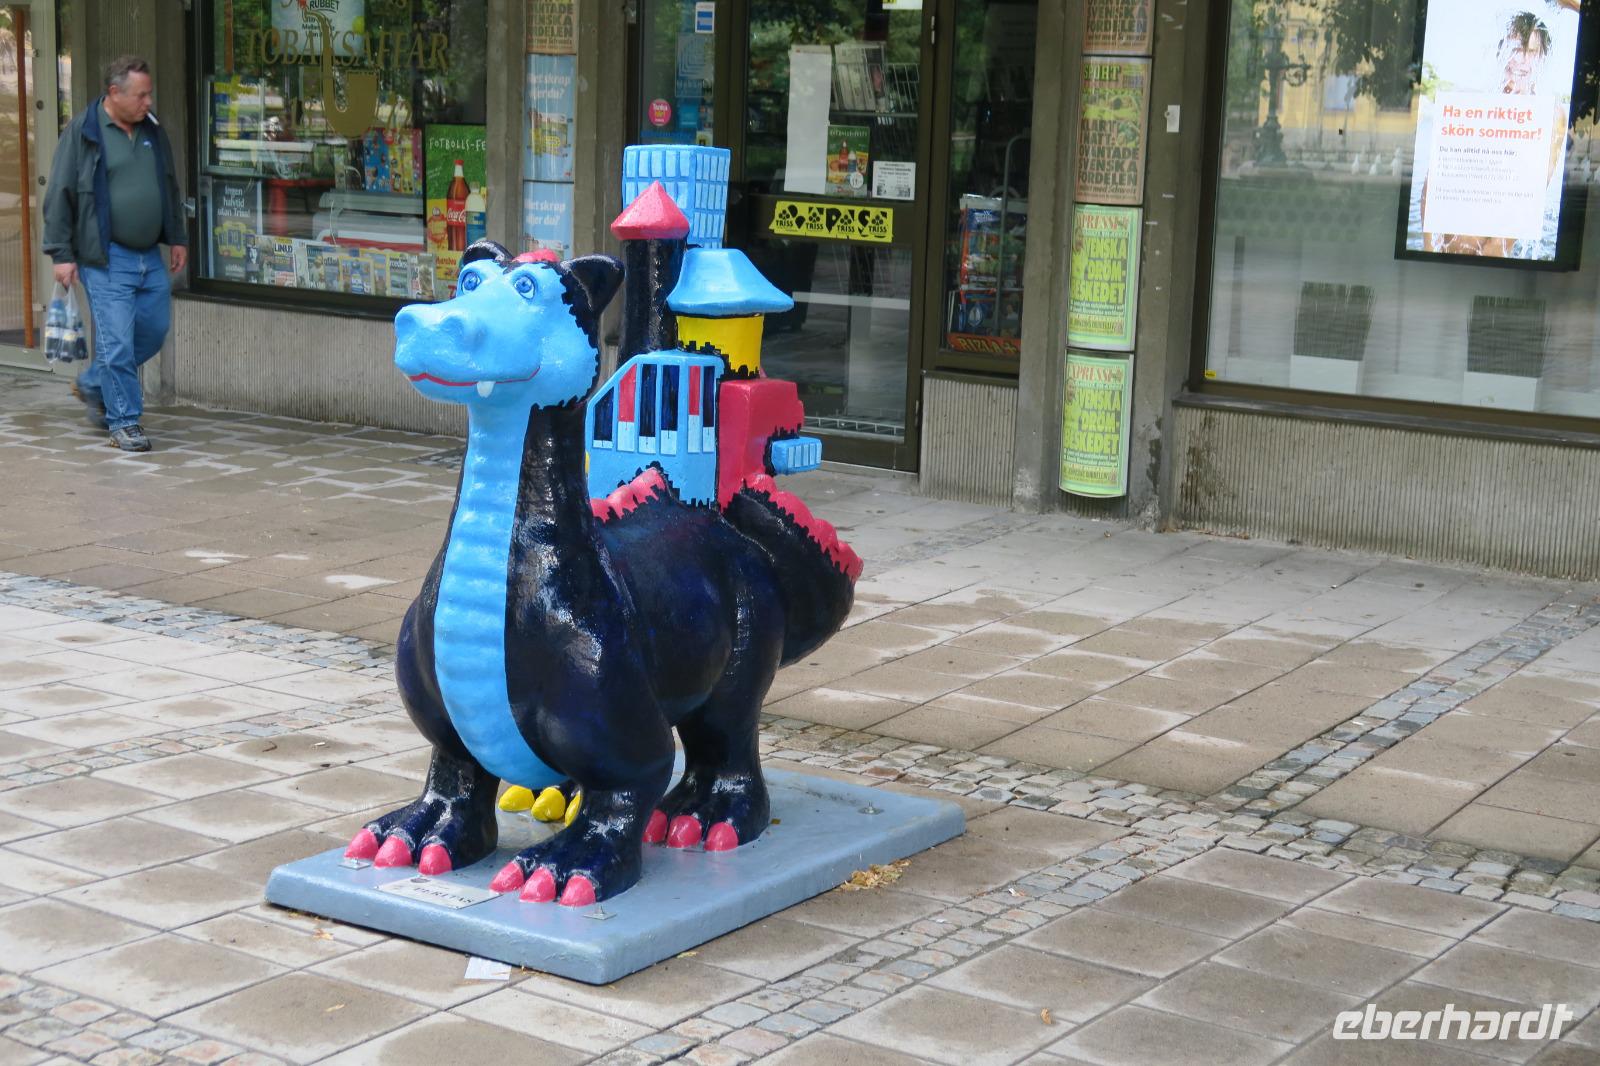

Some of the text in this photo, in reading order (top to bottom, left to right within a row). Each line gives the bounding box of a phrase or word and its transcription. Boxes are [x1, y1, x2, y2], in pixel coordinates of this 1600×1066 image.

[1443, 105, 1533, 124] Ha en riktigt
[1441, 123, 1542, 141] skön sommar!
[1078, 158, 1137, 173] SVENSKA
[806, 222, 824, 230] TRISS
[837, 225, 855, 233] TRISS
[868, 225, 888, 233] TRISS
